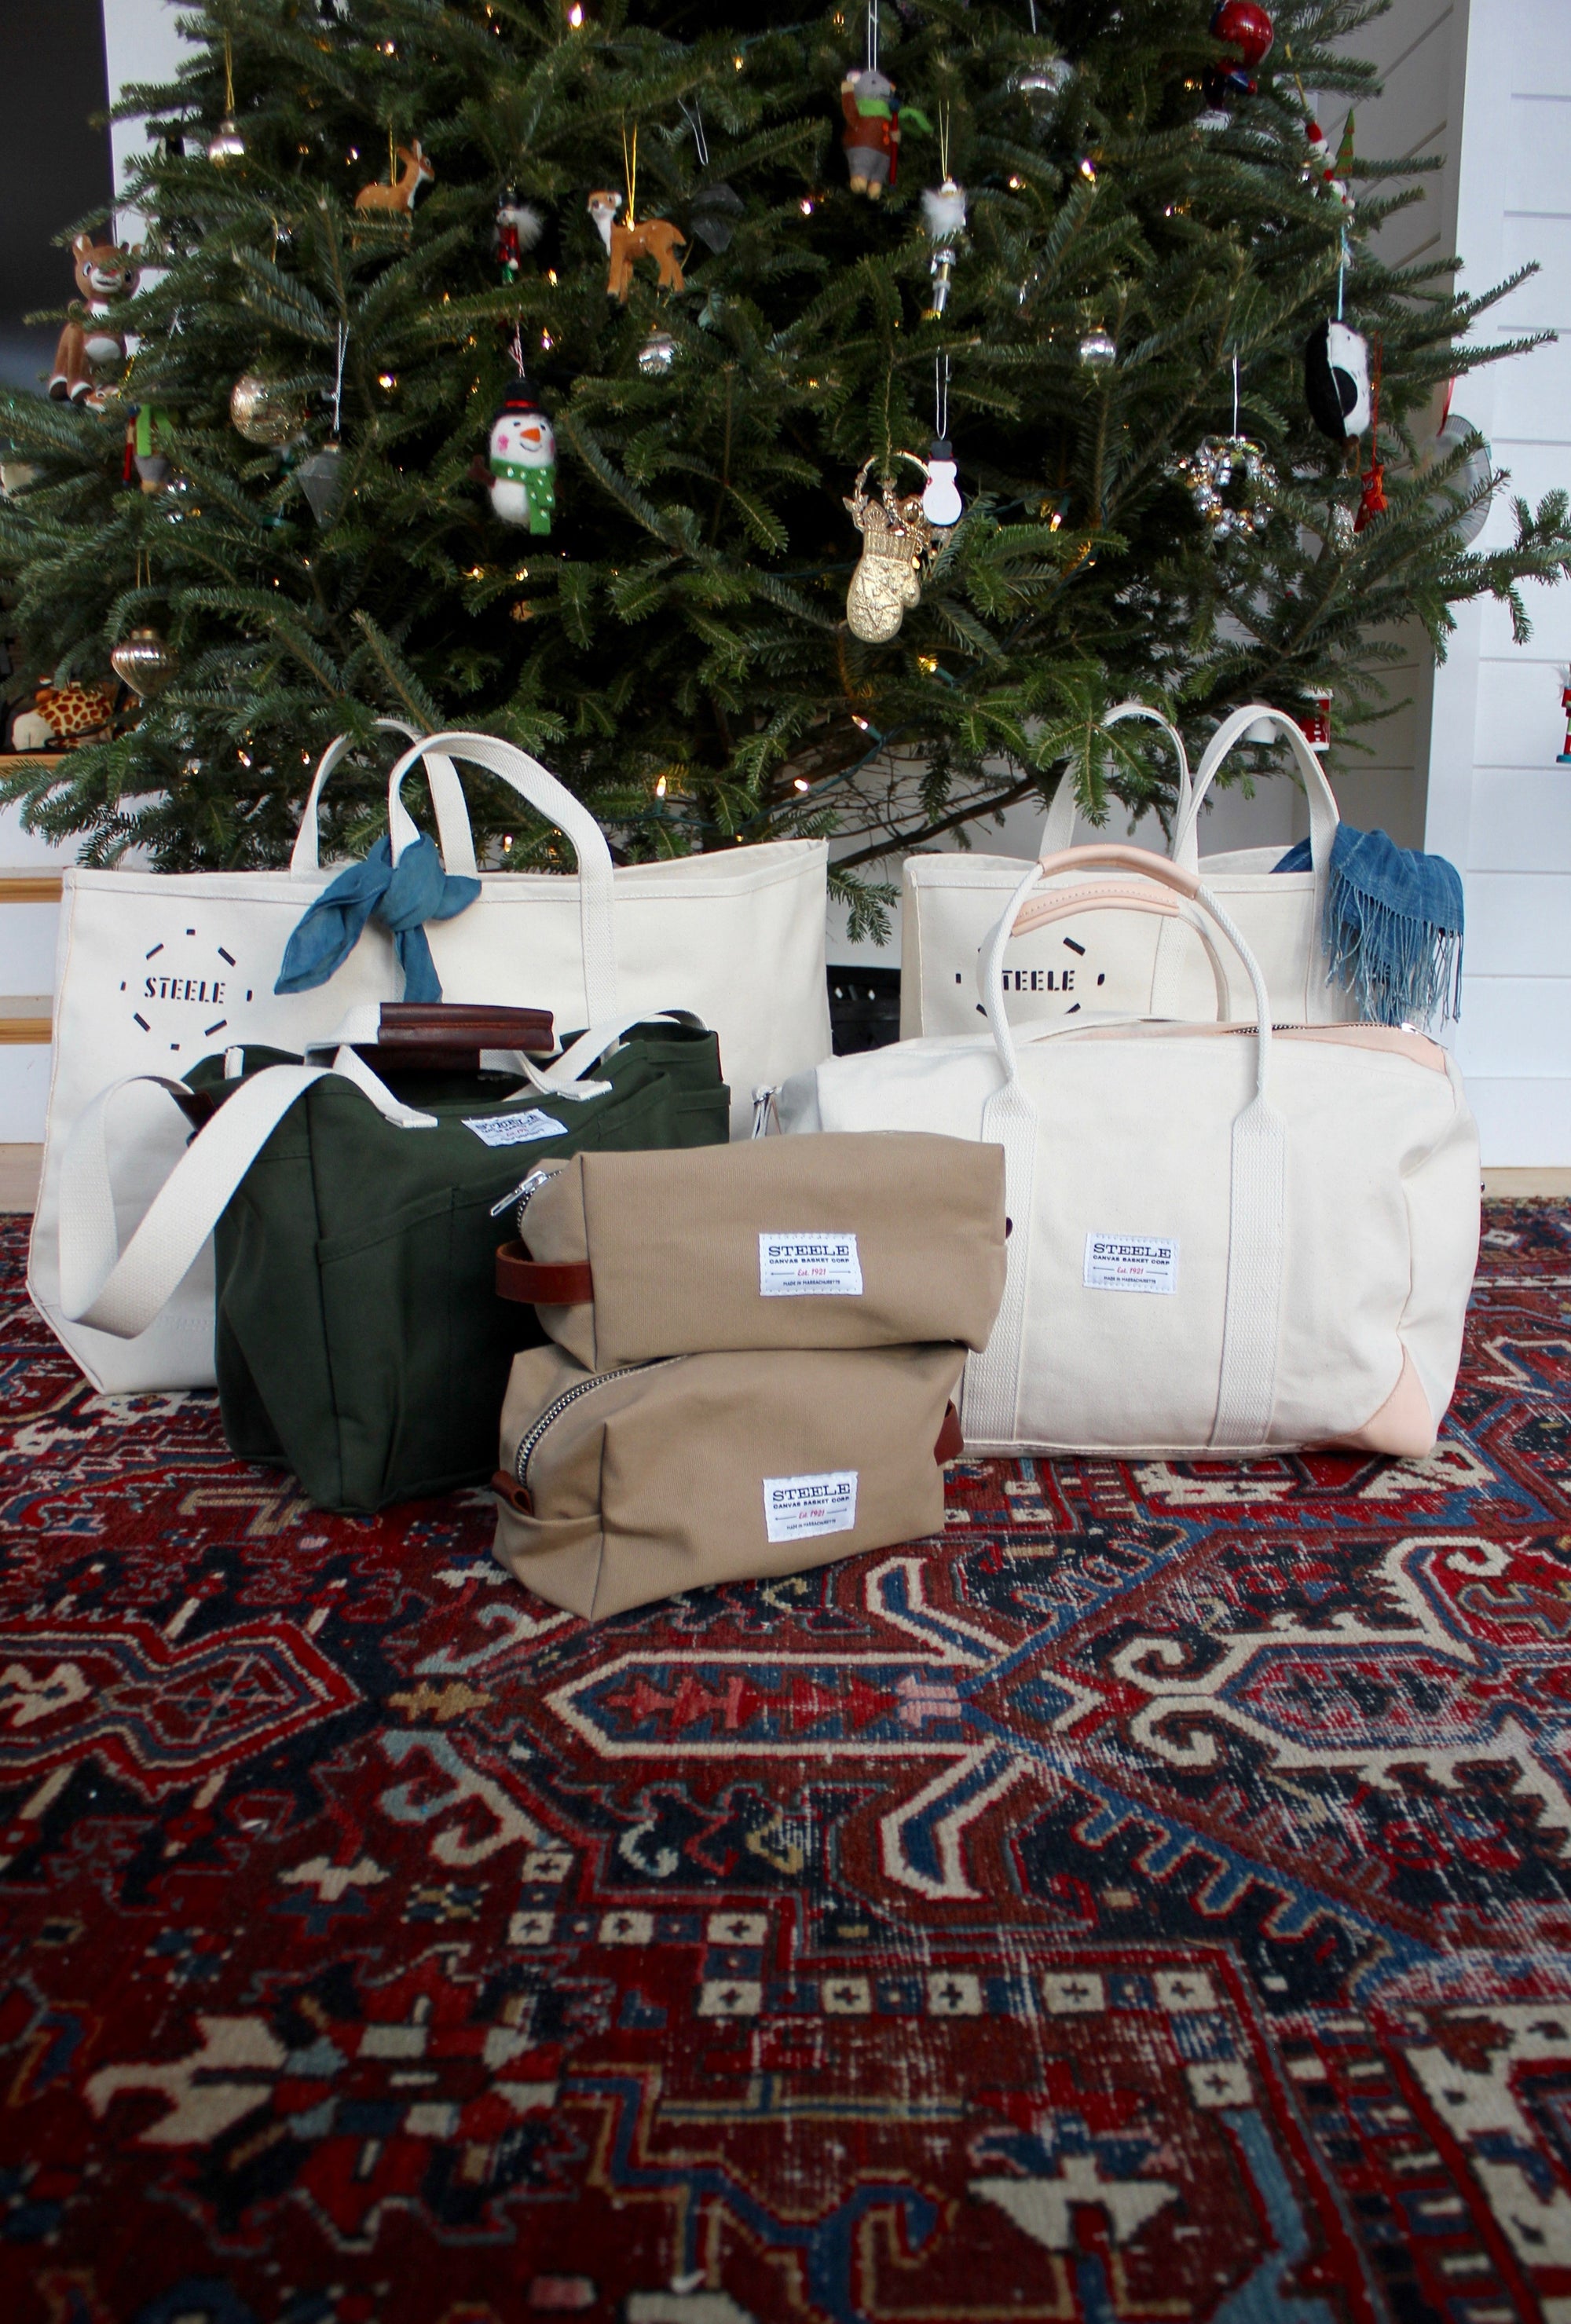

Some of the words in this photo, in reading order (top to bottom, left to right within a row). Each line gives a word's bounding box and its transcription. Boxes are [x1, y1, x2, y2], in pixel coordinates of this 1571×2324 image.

[1002, 970, 1075, 990] TEELE
[144, 977, 226, 1004] STEELE
[768, 1245, 850, 1257] STEELE
[1093, 1243, 1171, 1259] STEELE
[773, 1484, 850, 1502] STEELE
[810, 1509, 825, 1517] 1921
